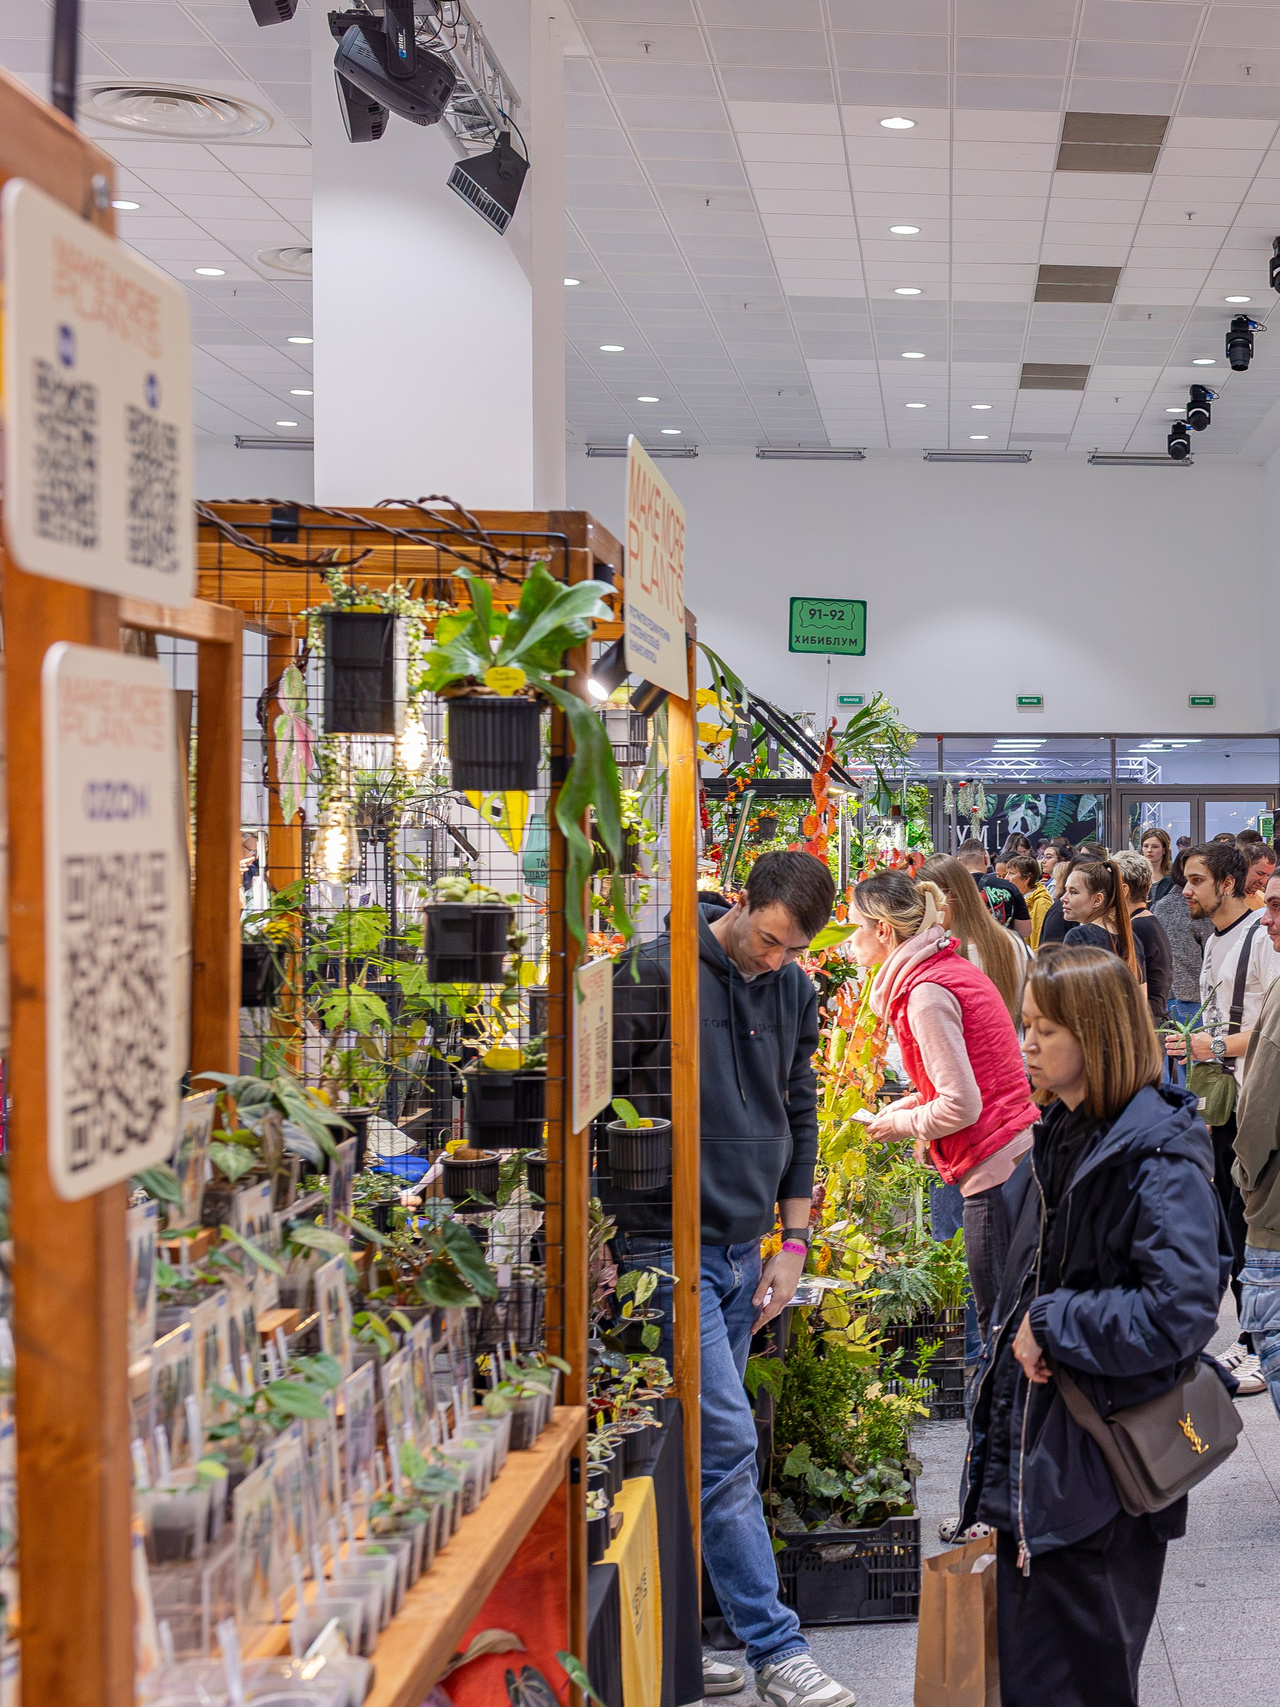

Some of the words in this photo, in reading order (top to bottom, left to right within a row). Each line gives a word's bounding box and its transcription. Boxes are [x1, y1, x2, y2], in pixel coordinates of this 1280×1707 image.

[629, 455, 661, 544] MAKE
[661, 496, 684, 573] MORE
[628, 519, 684, 624] PLANTS
[794, 635, 858, 647] ХИБИБЛУМ
[808, 608, 845, 621] 91-92
